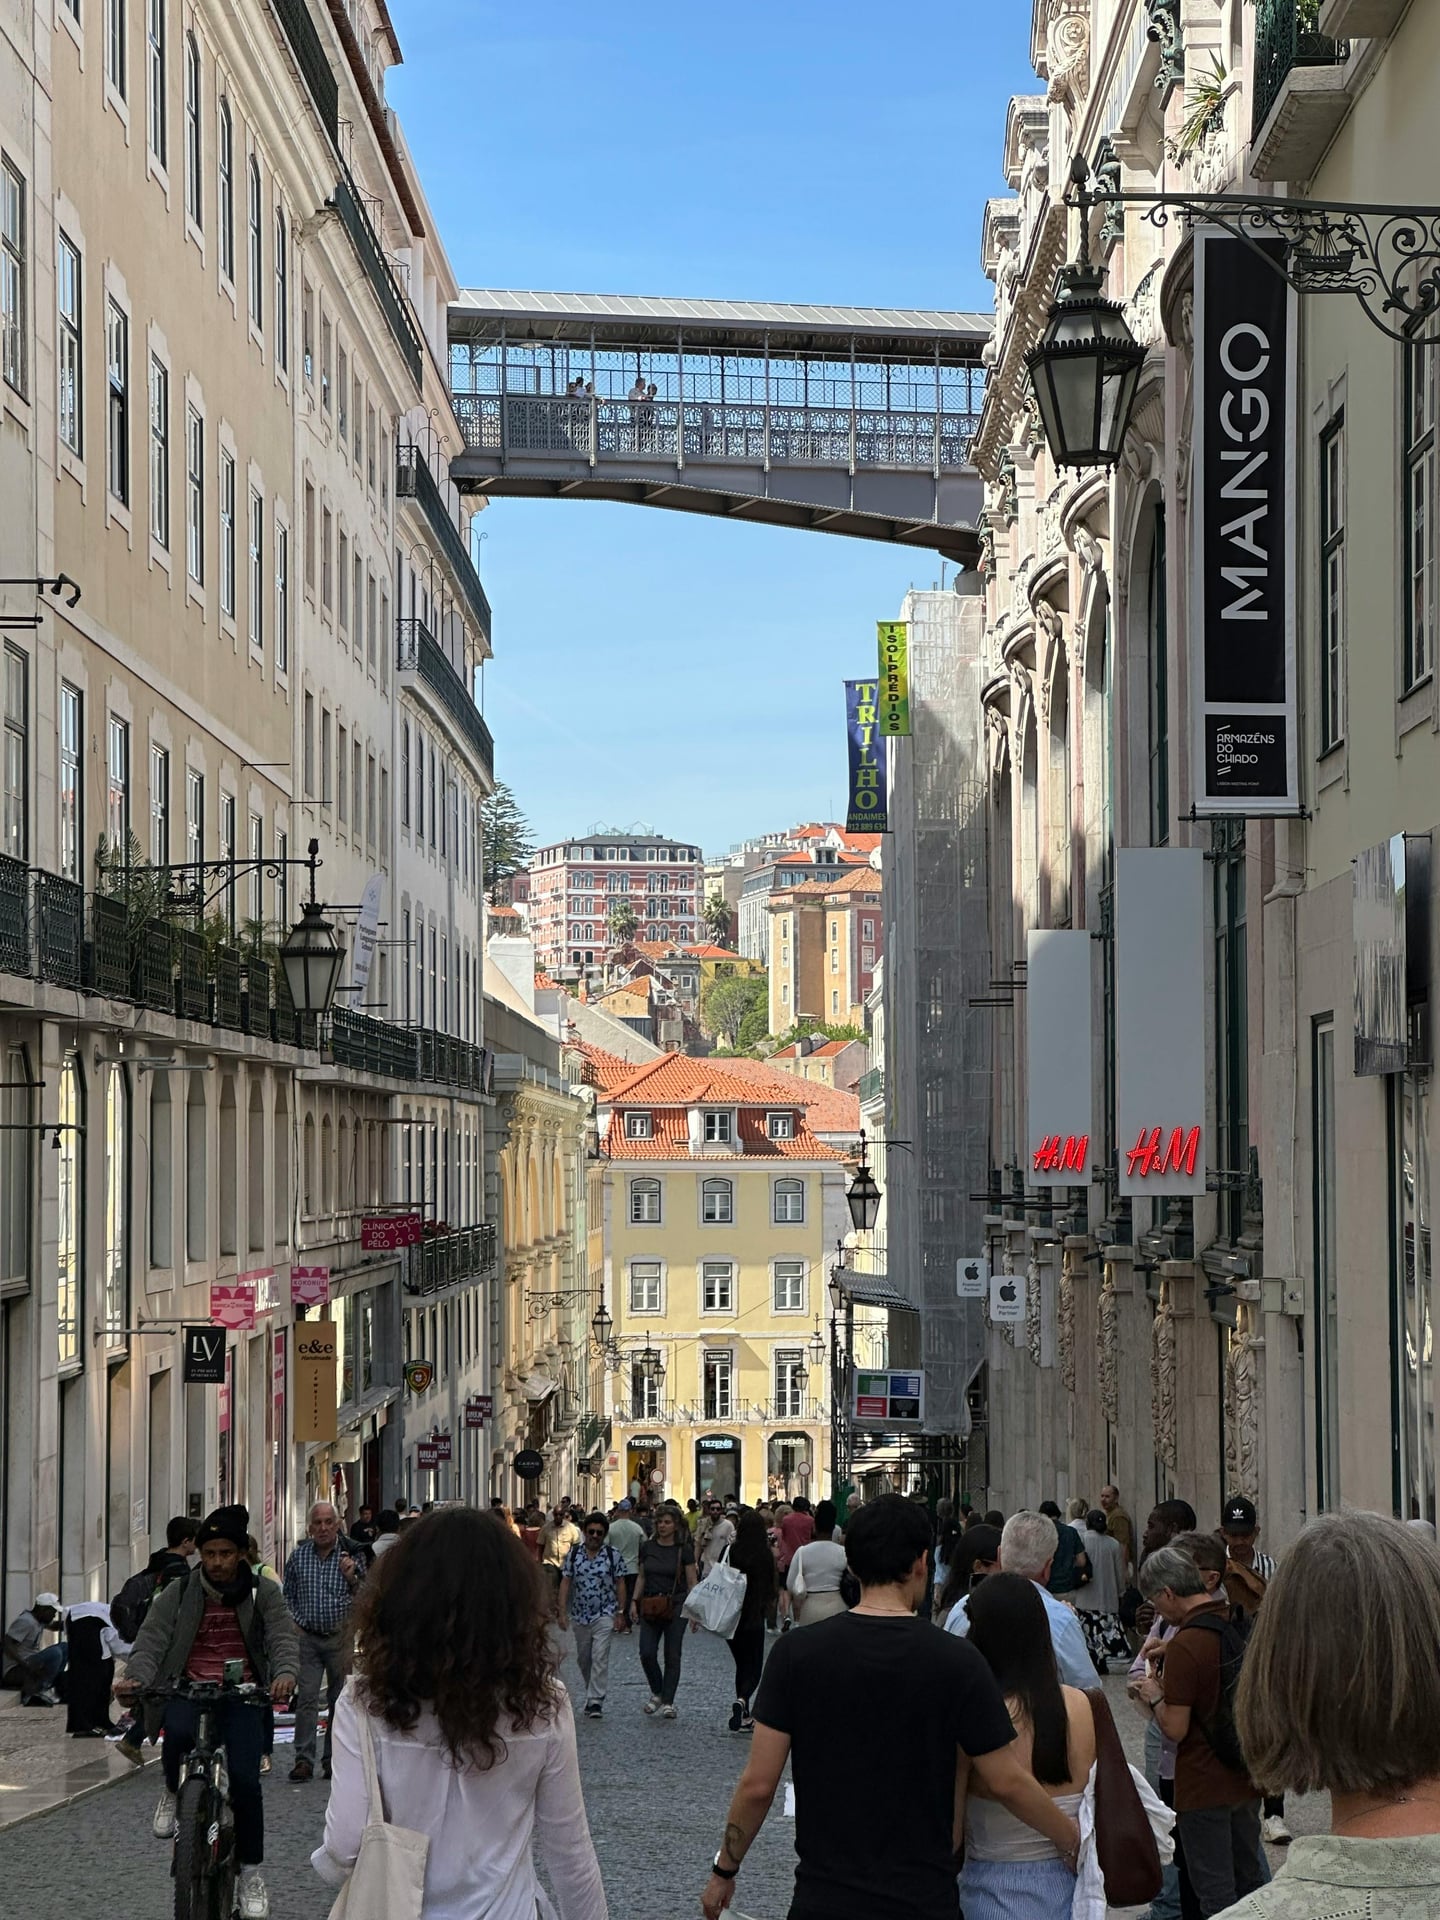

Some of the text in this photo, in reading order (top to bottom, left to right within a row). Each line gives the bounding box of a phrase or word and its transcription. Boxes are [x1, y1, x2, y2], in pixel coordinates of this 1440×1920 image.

[1219, 323, 1270, 620] MANGO
[1216, 732, 1275, 744] ARMAZÉNS
[855, 683, 880, 810] TRILHO
[1216, 744, 1234, 753] DO
[1216, 754, 1259, 764] CHIADO
[848, 812, 886, 821] ANDAIMES
[1033, 1135, 1089, 1173] H&M
[1126, 1126, 1200, 1177] H&M
[371, 1231, 386, 1239] DO
[192, 1336, 220, 1362] LV
[298, 1339, 333, 1354] e&e
[419, 1450, 437, 1458] MUJI
